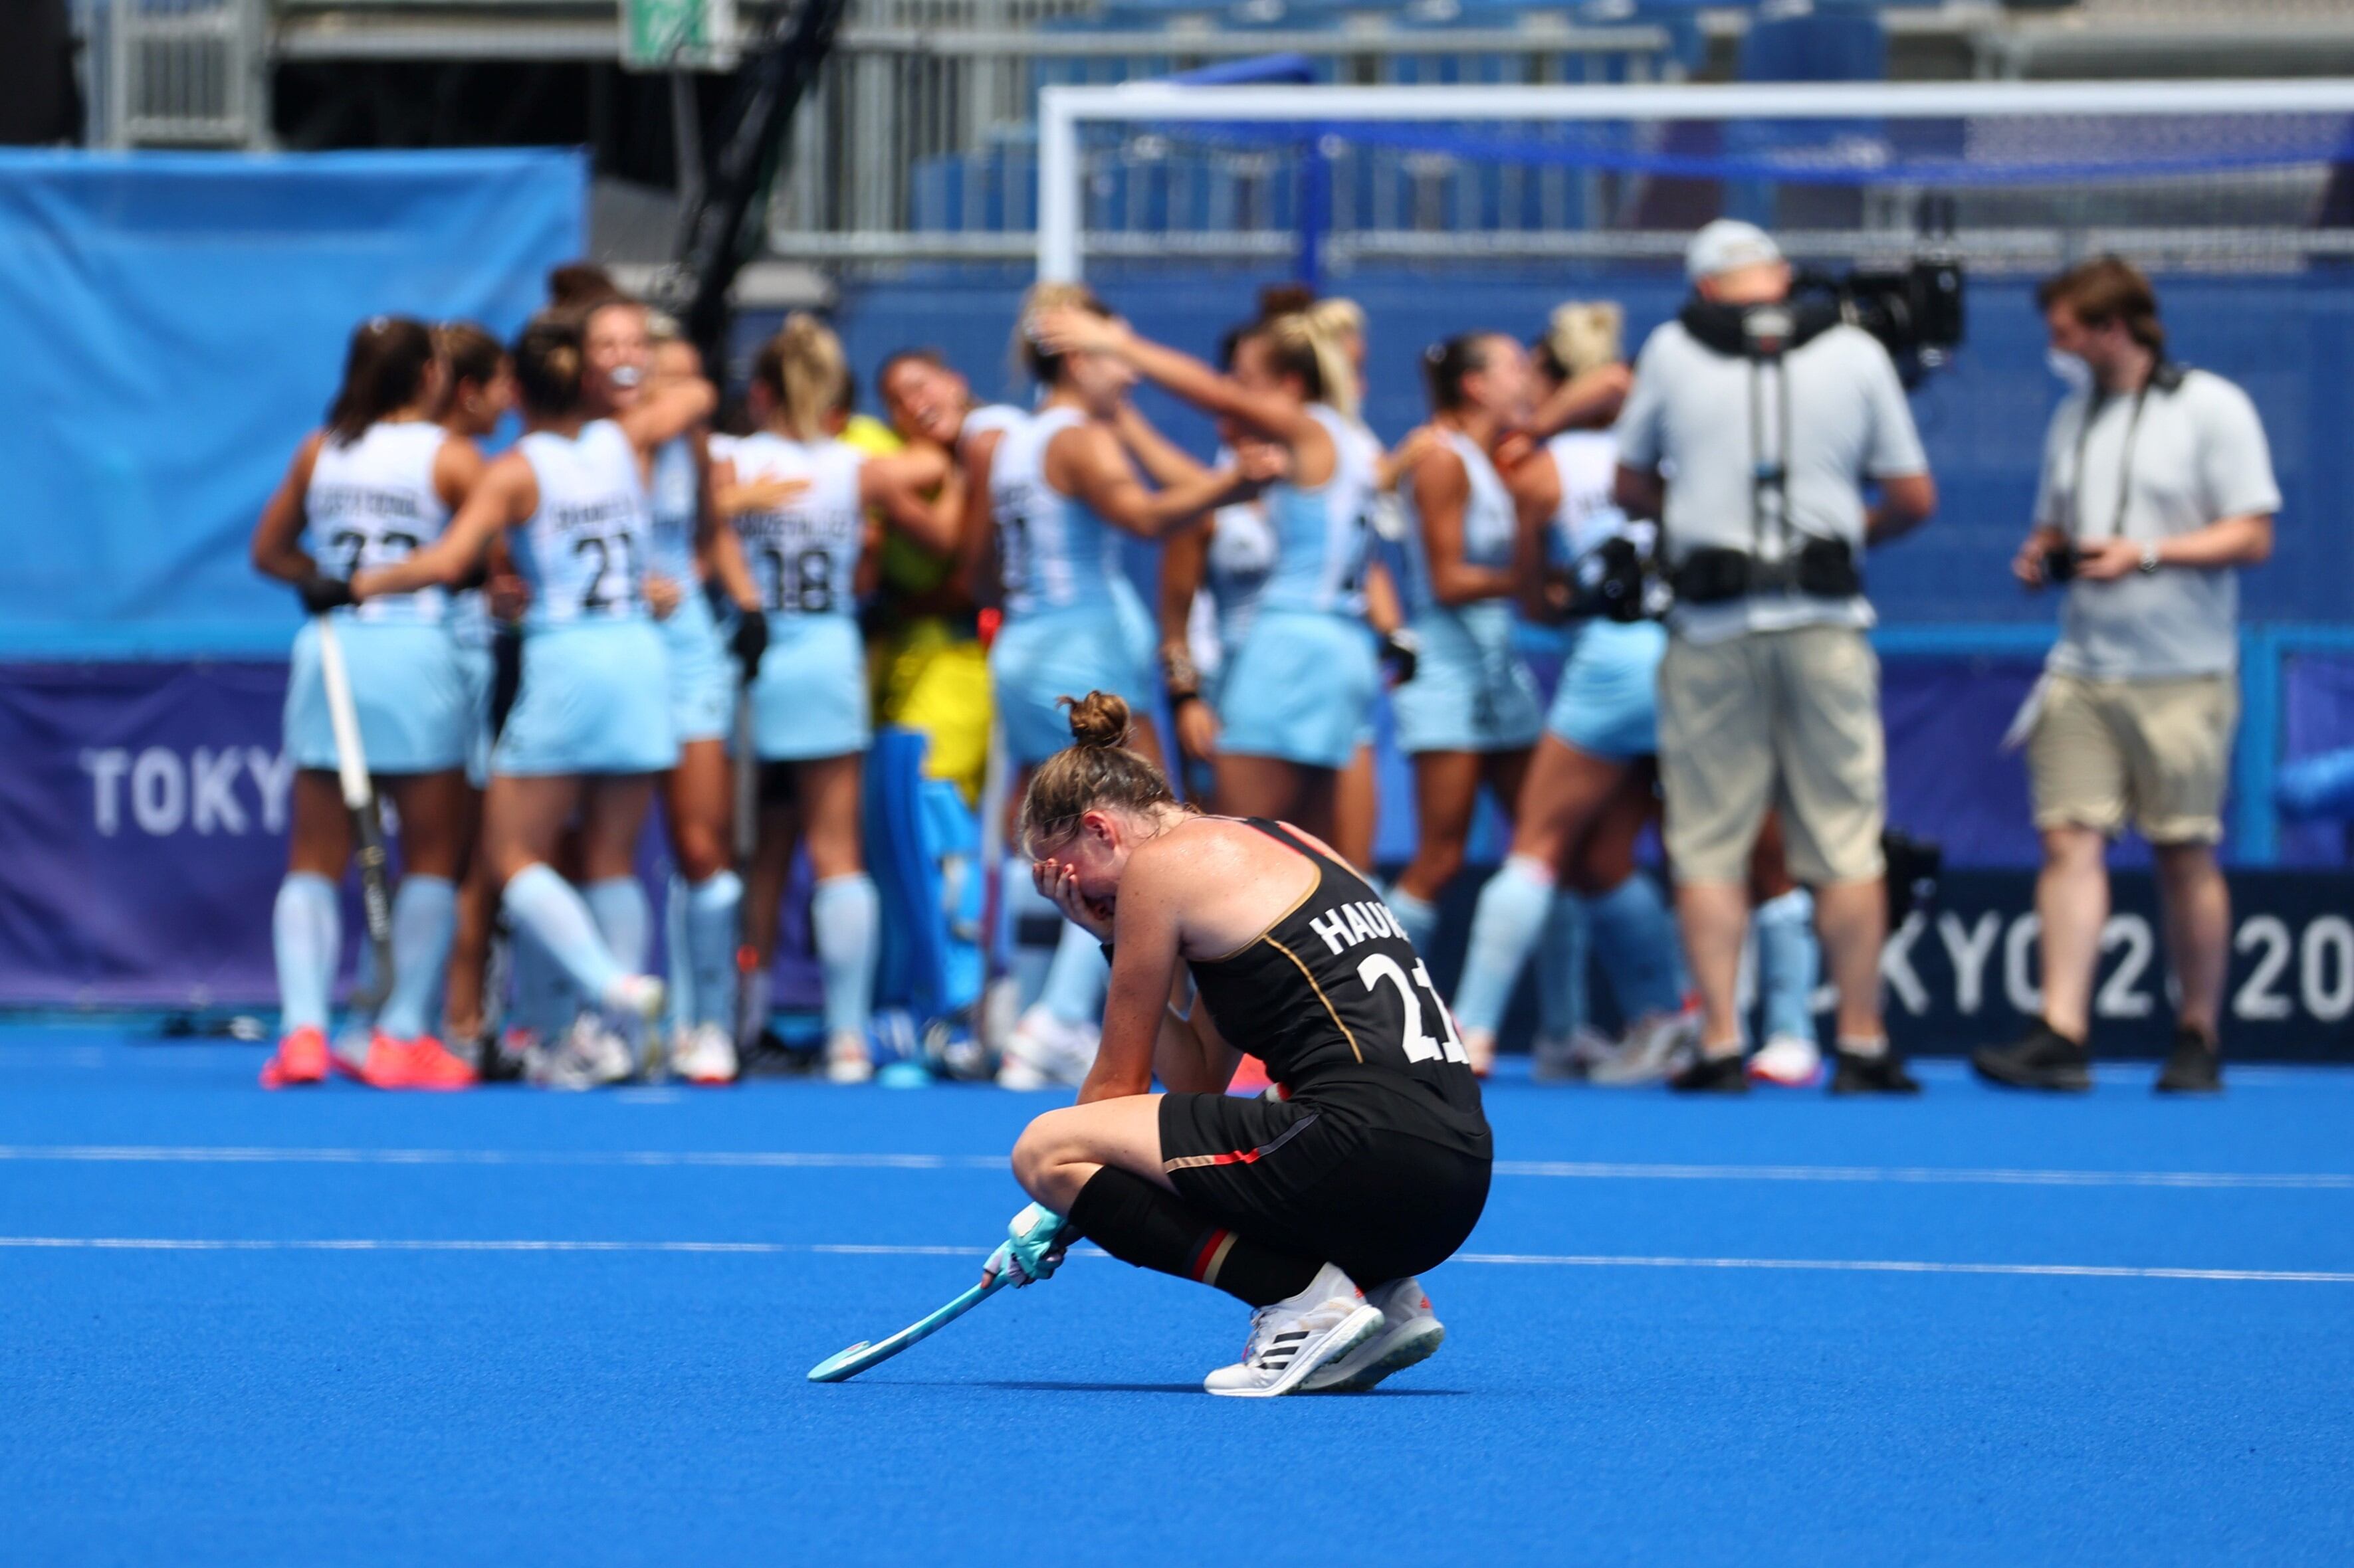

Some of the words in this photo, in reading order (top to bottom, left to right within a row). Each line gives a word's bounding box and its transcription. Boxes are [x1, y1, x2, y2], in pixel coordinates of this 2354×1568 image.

[330, 528, 420, 582] 2
[572, 532, 637, 609] 21
[762, 546, 832, 614] 18
[74, 745, 298, 837] TOKY
[1356, 953, 1470, 1064] 21
[2095, 913, 2354, 1022] 220
